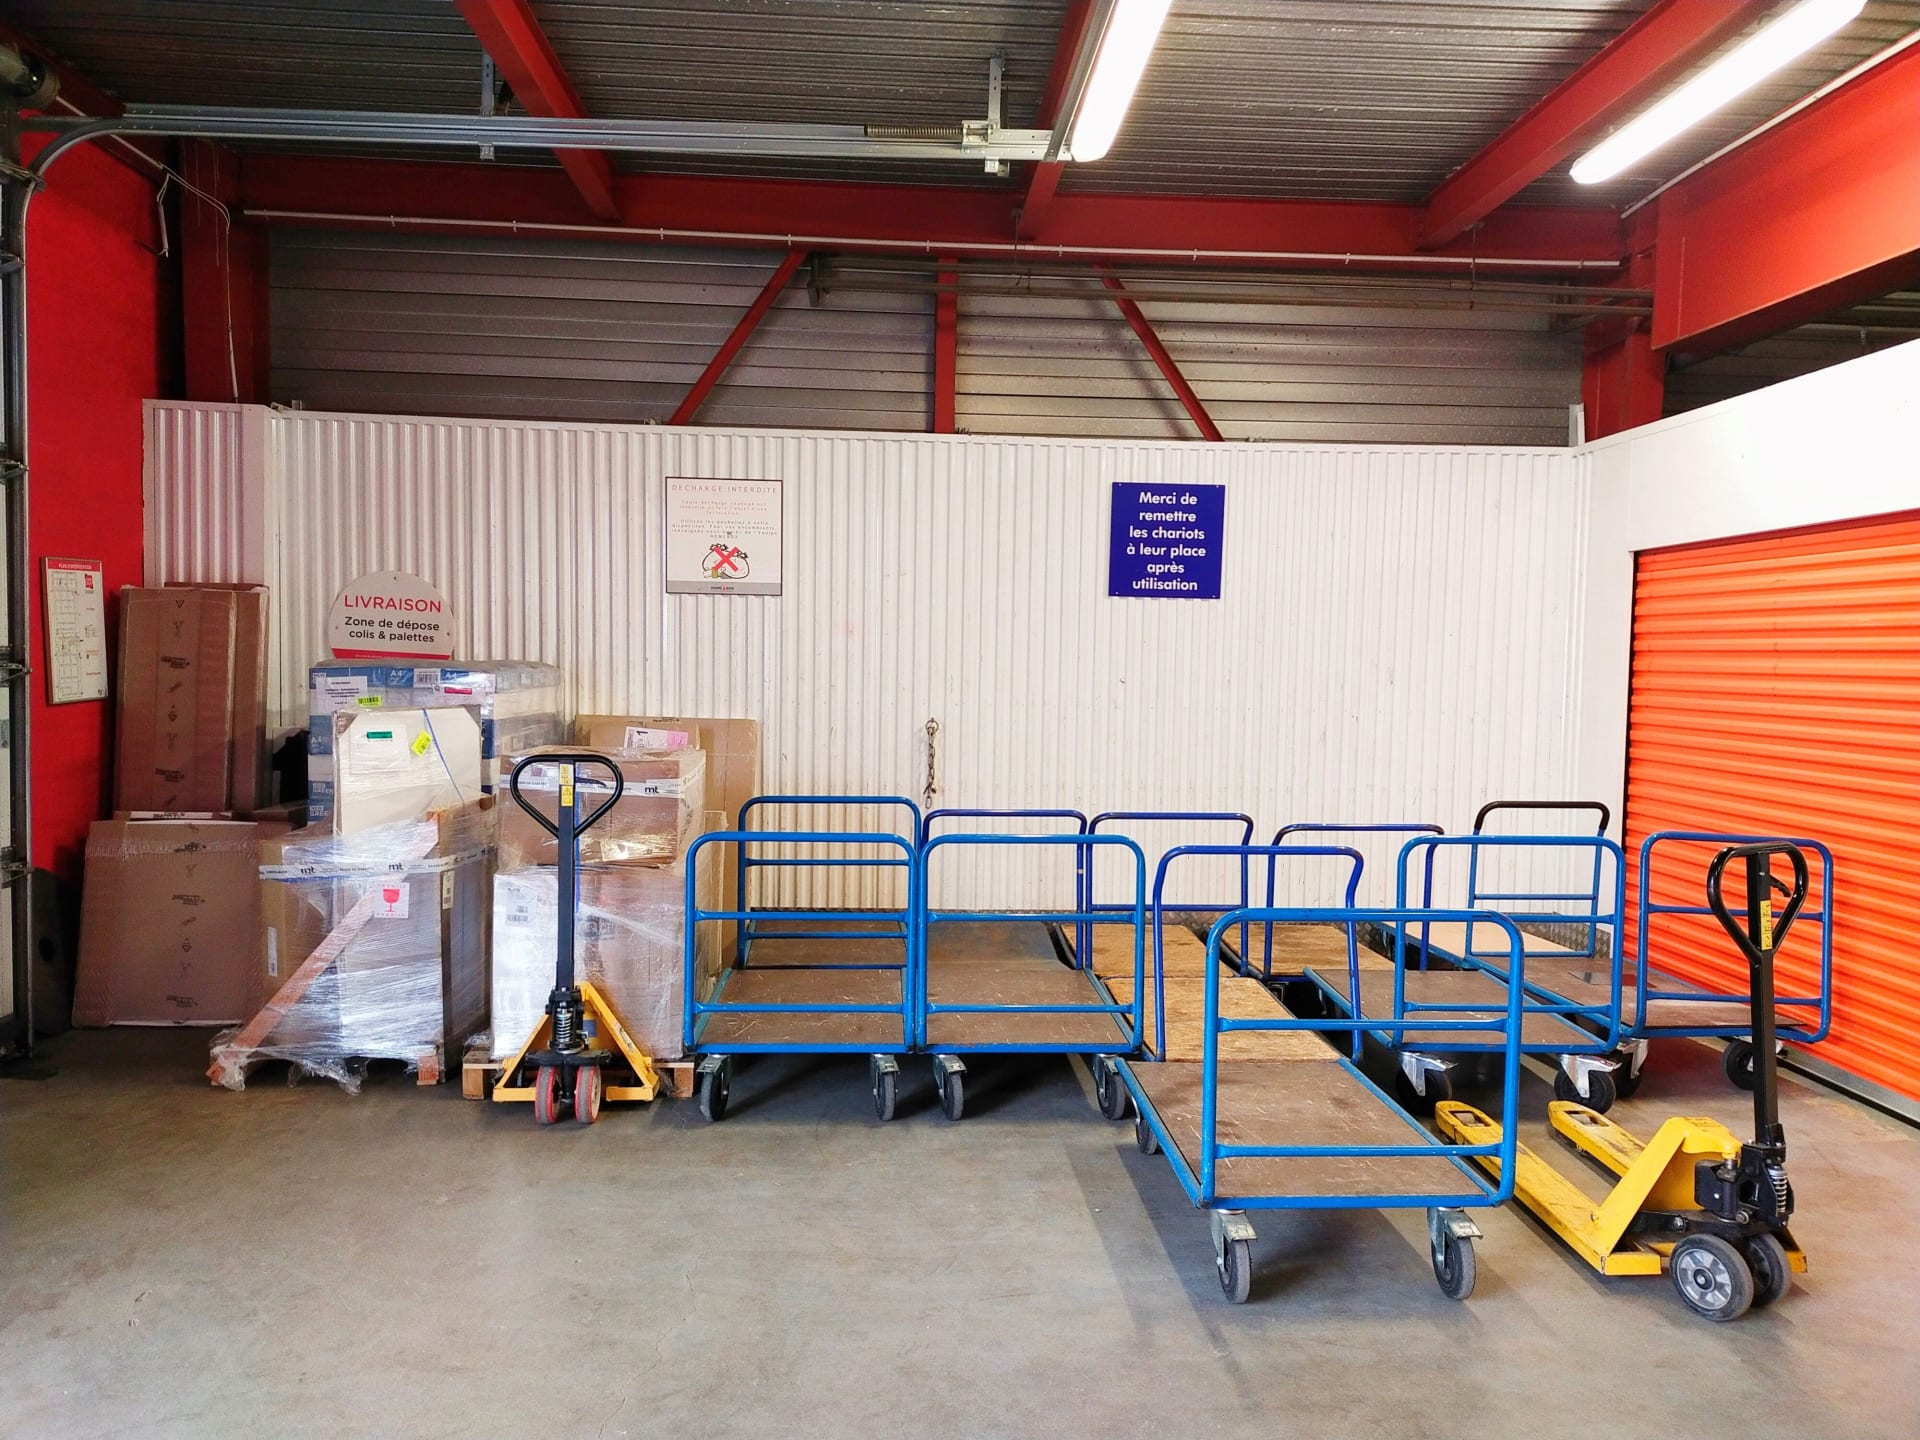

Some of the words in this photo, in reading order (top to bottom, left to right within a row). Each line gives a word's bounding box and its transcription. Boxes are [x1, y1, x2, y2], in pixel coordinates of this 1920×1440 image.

[672, 484, 722, 492] DECHARGE
[727, 486, 777, 494] INTERDITE
[1139, 492, 1176, 504] Merci
[1180, 492, 1198, 505] de
[1139, 511, 1196, 522] remettre
[1129, 526, 1148, 538] les
[1152, 527, 1205, 539] chariots
[1126, 543, 1135, 554] à
[1140, 543, 1167, 555] leur
[1170, 544, 1206, 559] place
[1147, 562, 1184, 575] après
[1132, 578, 1198, 591] utilisation
[344, 595, 441, 613] LIVRAISON
[345, 616, 374, 627] Zone
[378, 619, 393, 628] de
[397, 619, 440, 632] dépose
[349, 630, 374, 639] colis
[378, 631, 386, 640] &
[389, 632, 434, 642] palettes
